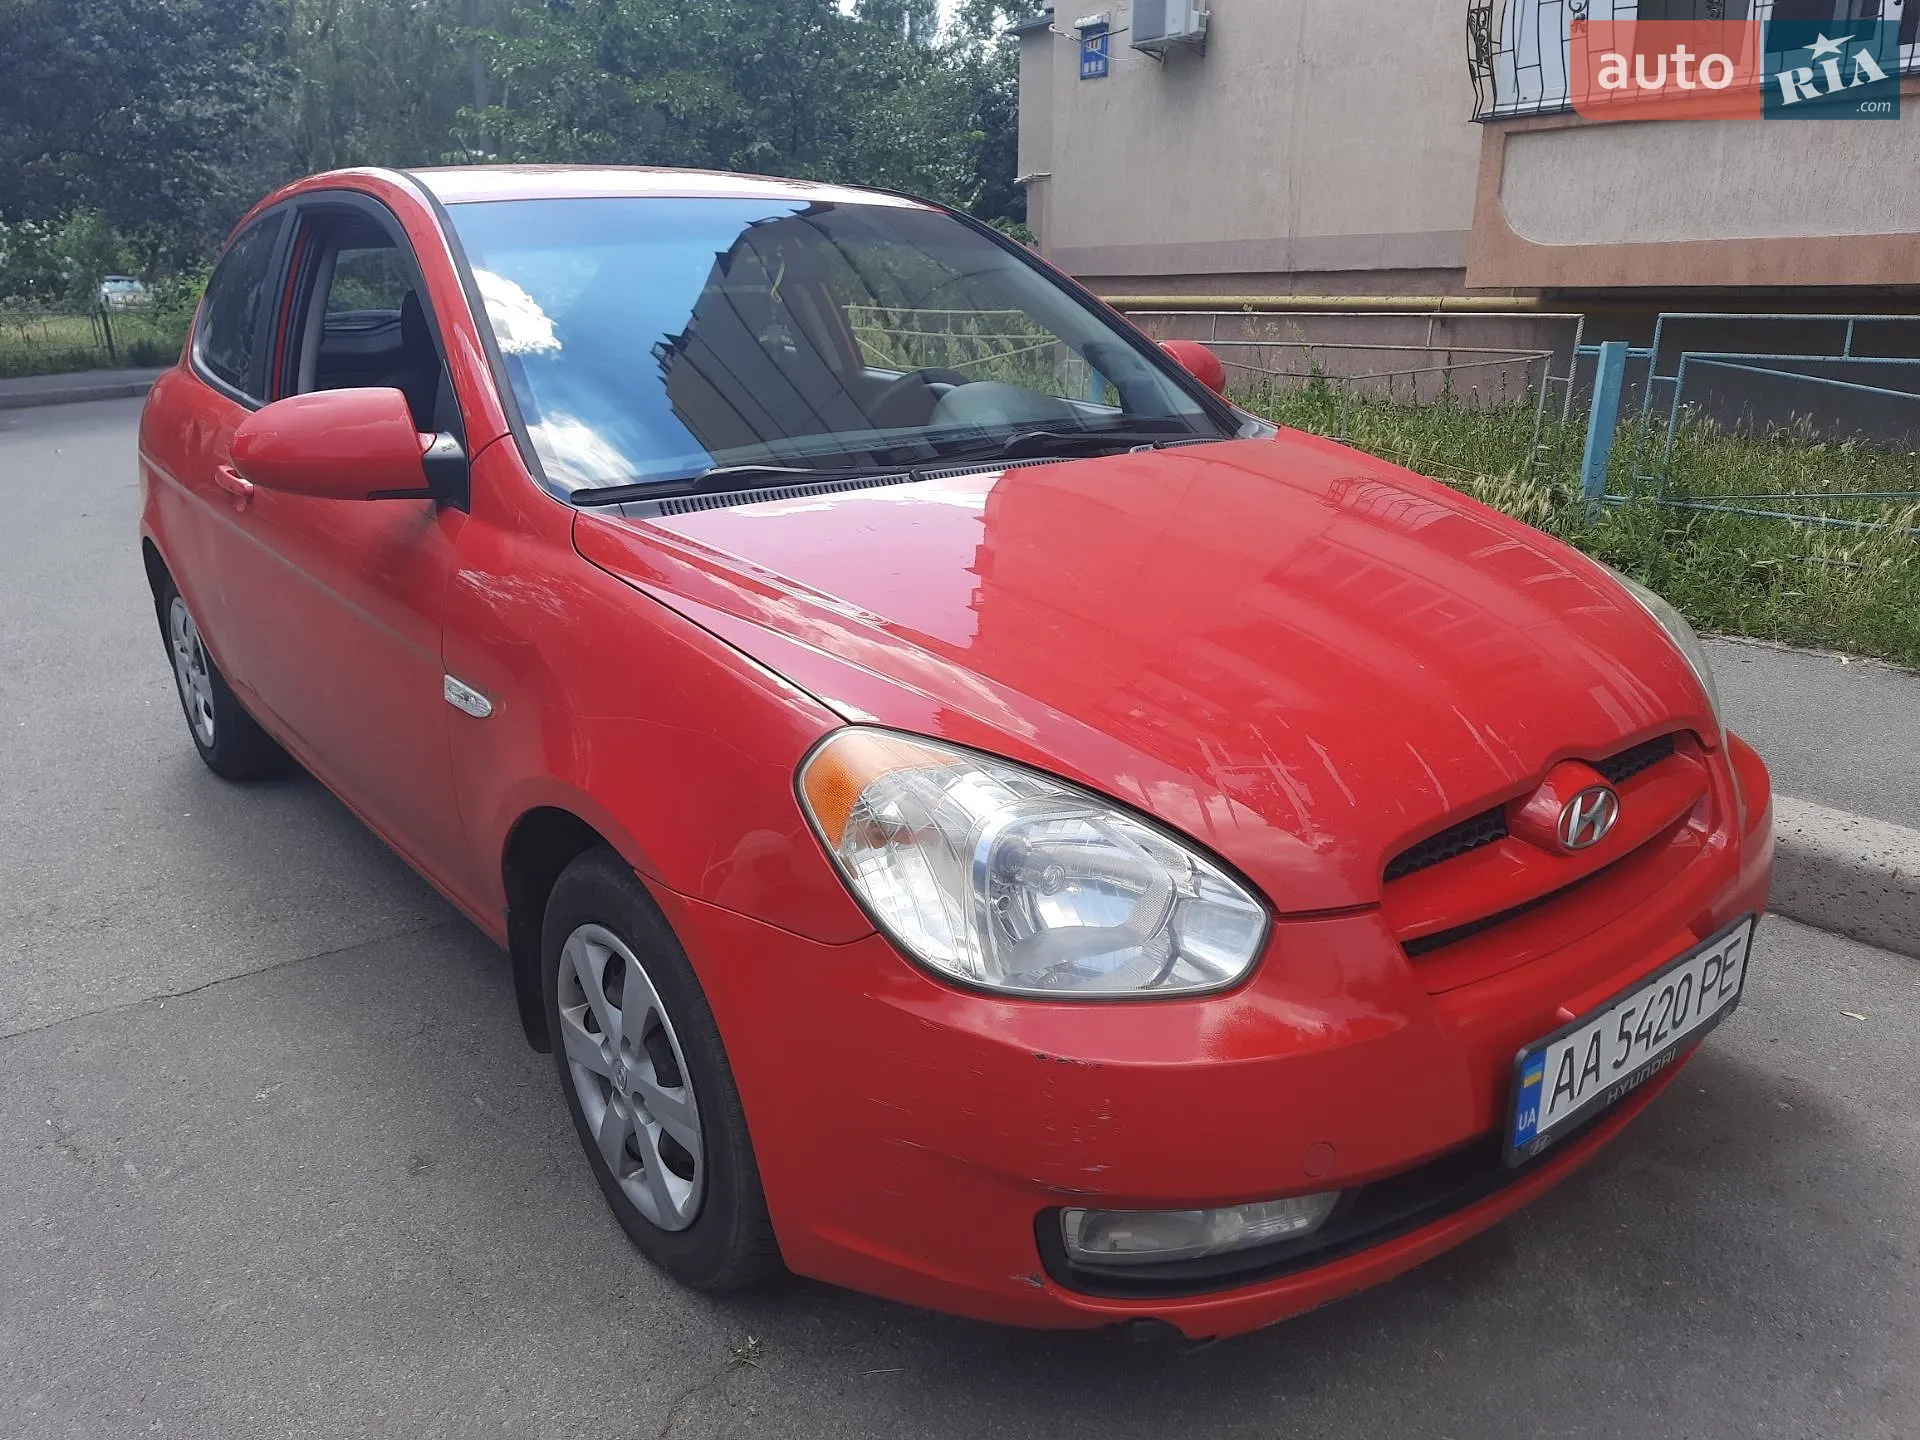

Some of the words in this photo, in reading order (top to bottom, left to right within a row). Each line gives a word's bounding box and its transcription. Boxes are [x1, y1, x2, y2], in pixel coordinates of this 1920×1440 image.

[1547, 1029, 1601, 1115] AA
[1612, 972, 1693, 1070] 5420
[1696, 937, 1742, 1014] PE
[1606, 1047, 1677, 1105] HYUNDAI
[1518, 1110, 1537, 1131] UA
